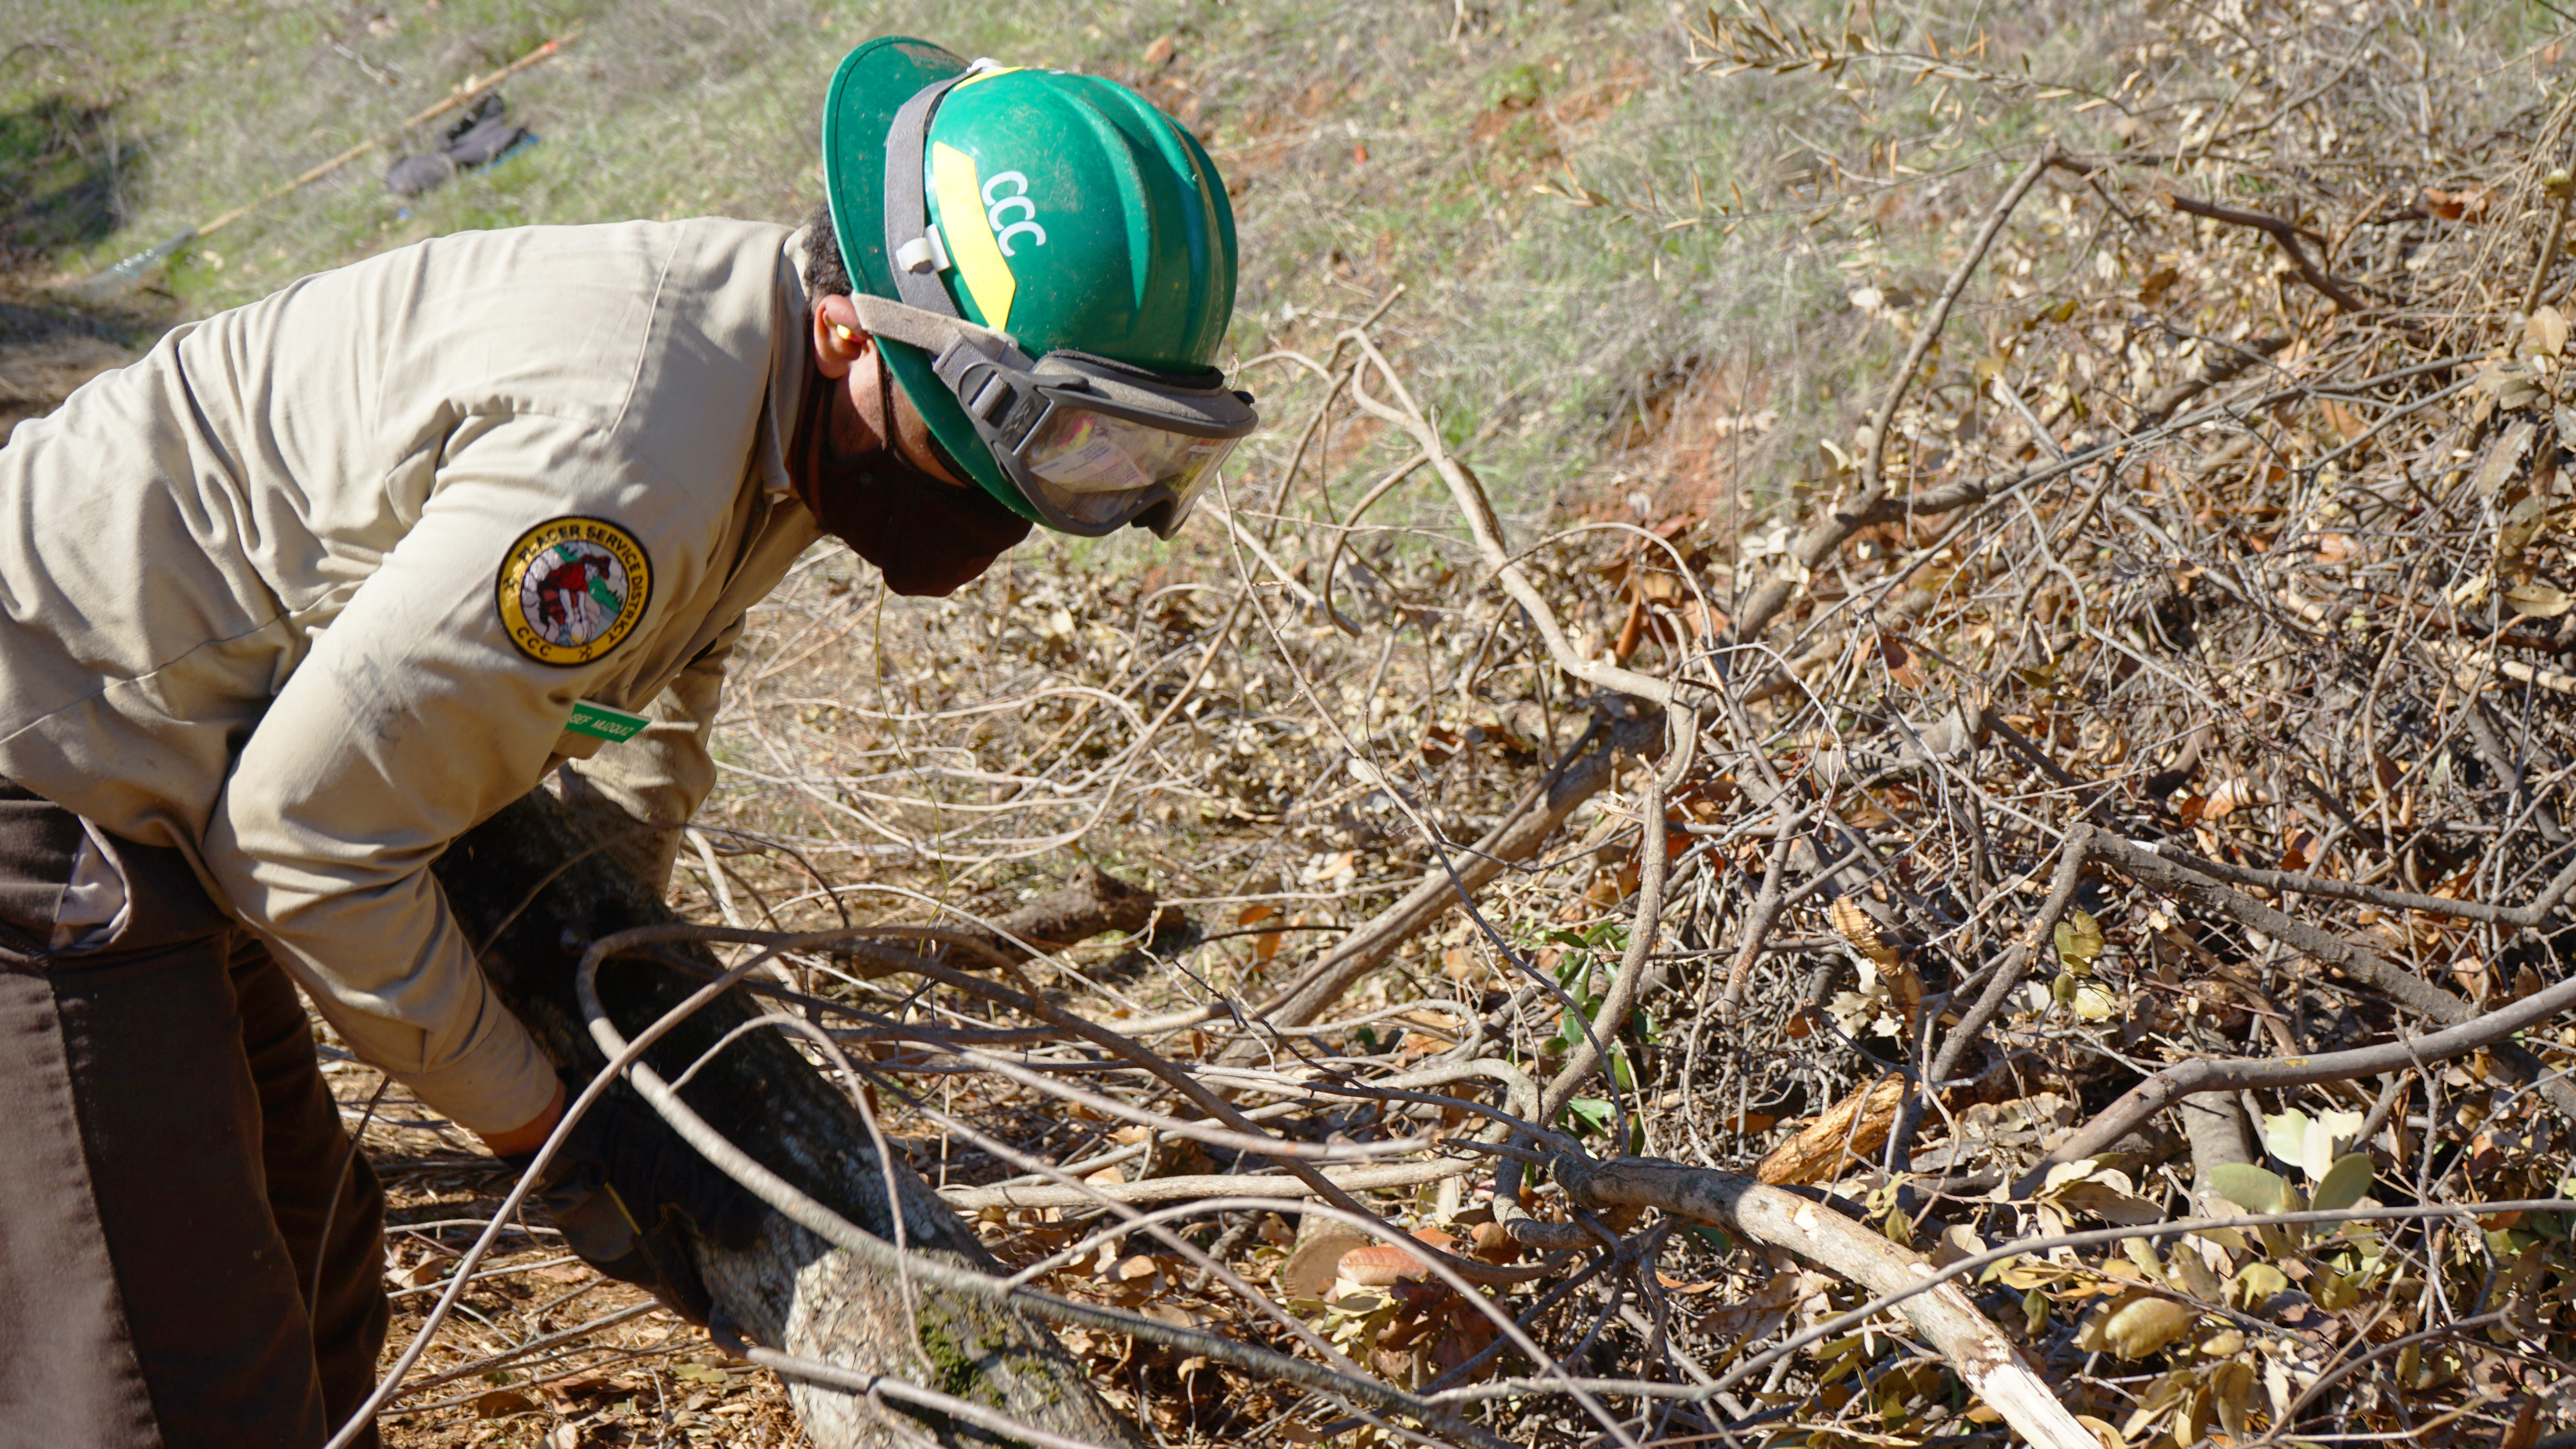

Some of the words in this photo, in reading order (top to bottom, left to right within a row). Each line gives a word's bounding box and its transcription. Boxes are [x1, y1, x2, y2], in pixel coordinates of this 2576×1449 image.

[981, 170, 1046, 257] CCC
[586, 526, 641, 574] SERVICE
[608, 574, 644, 644] DISTRICT
[517, 626, 551, 656] CCC
